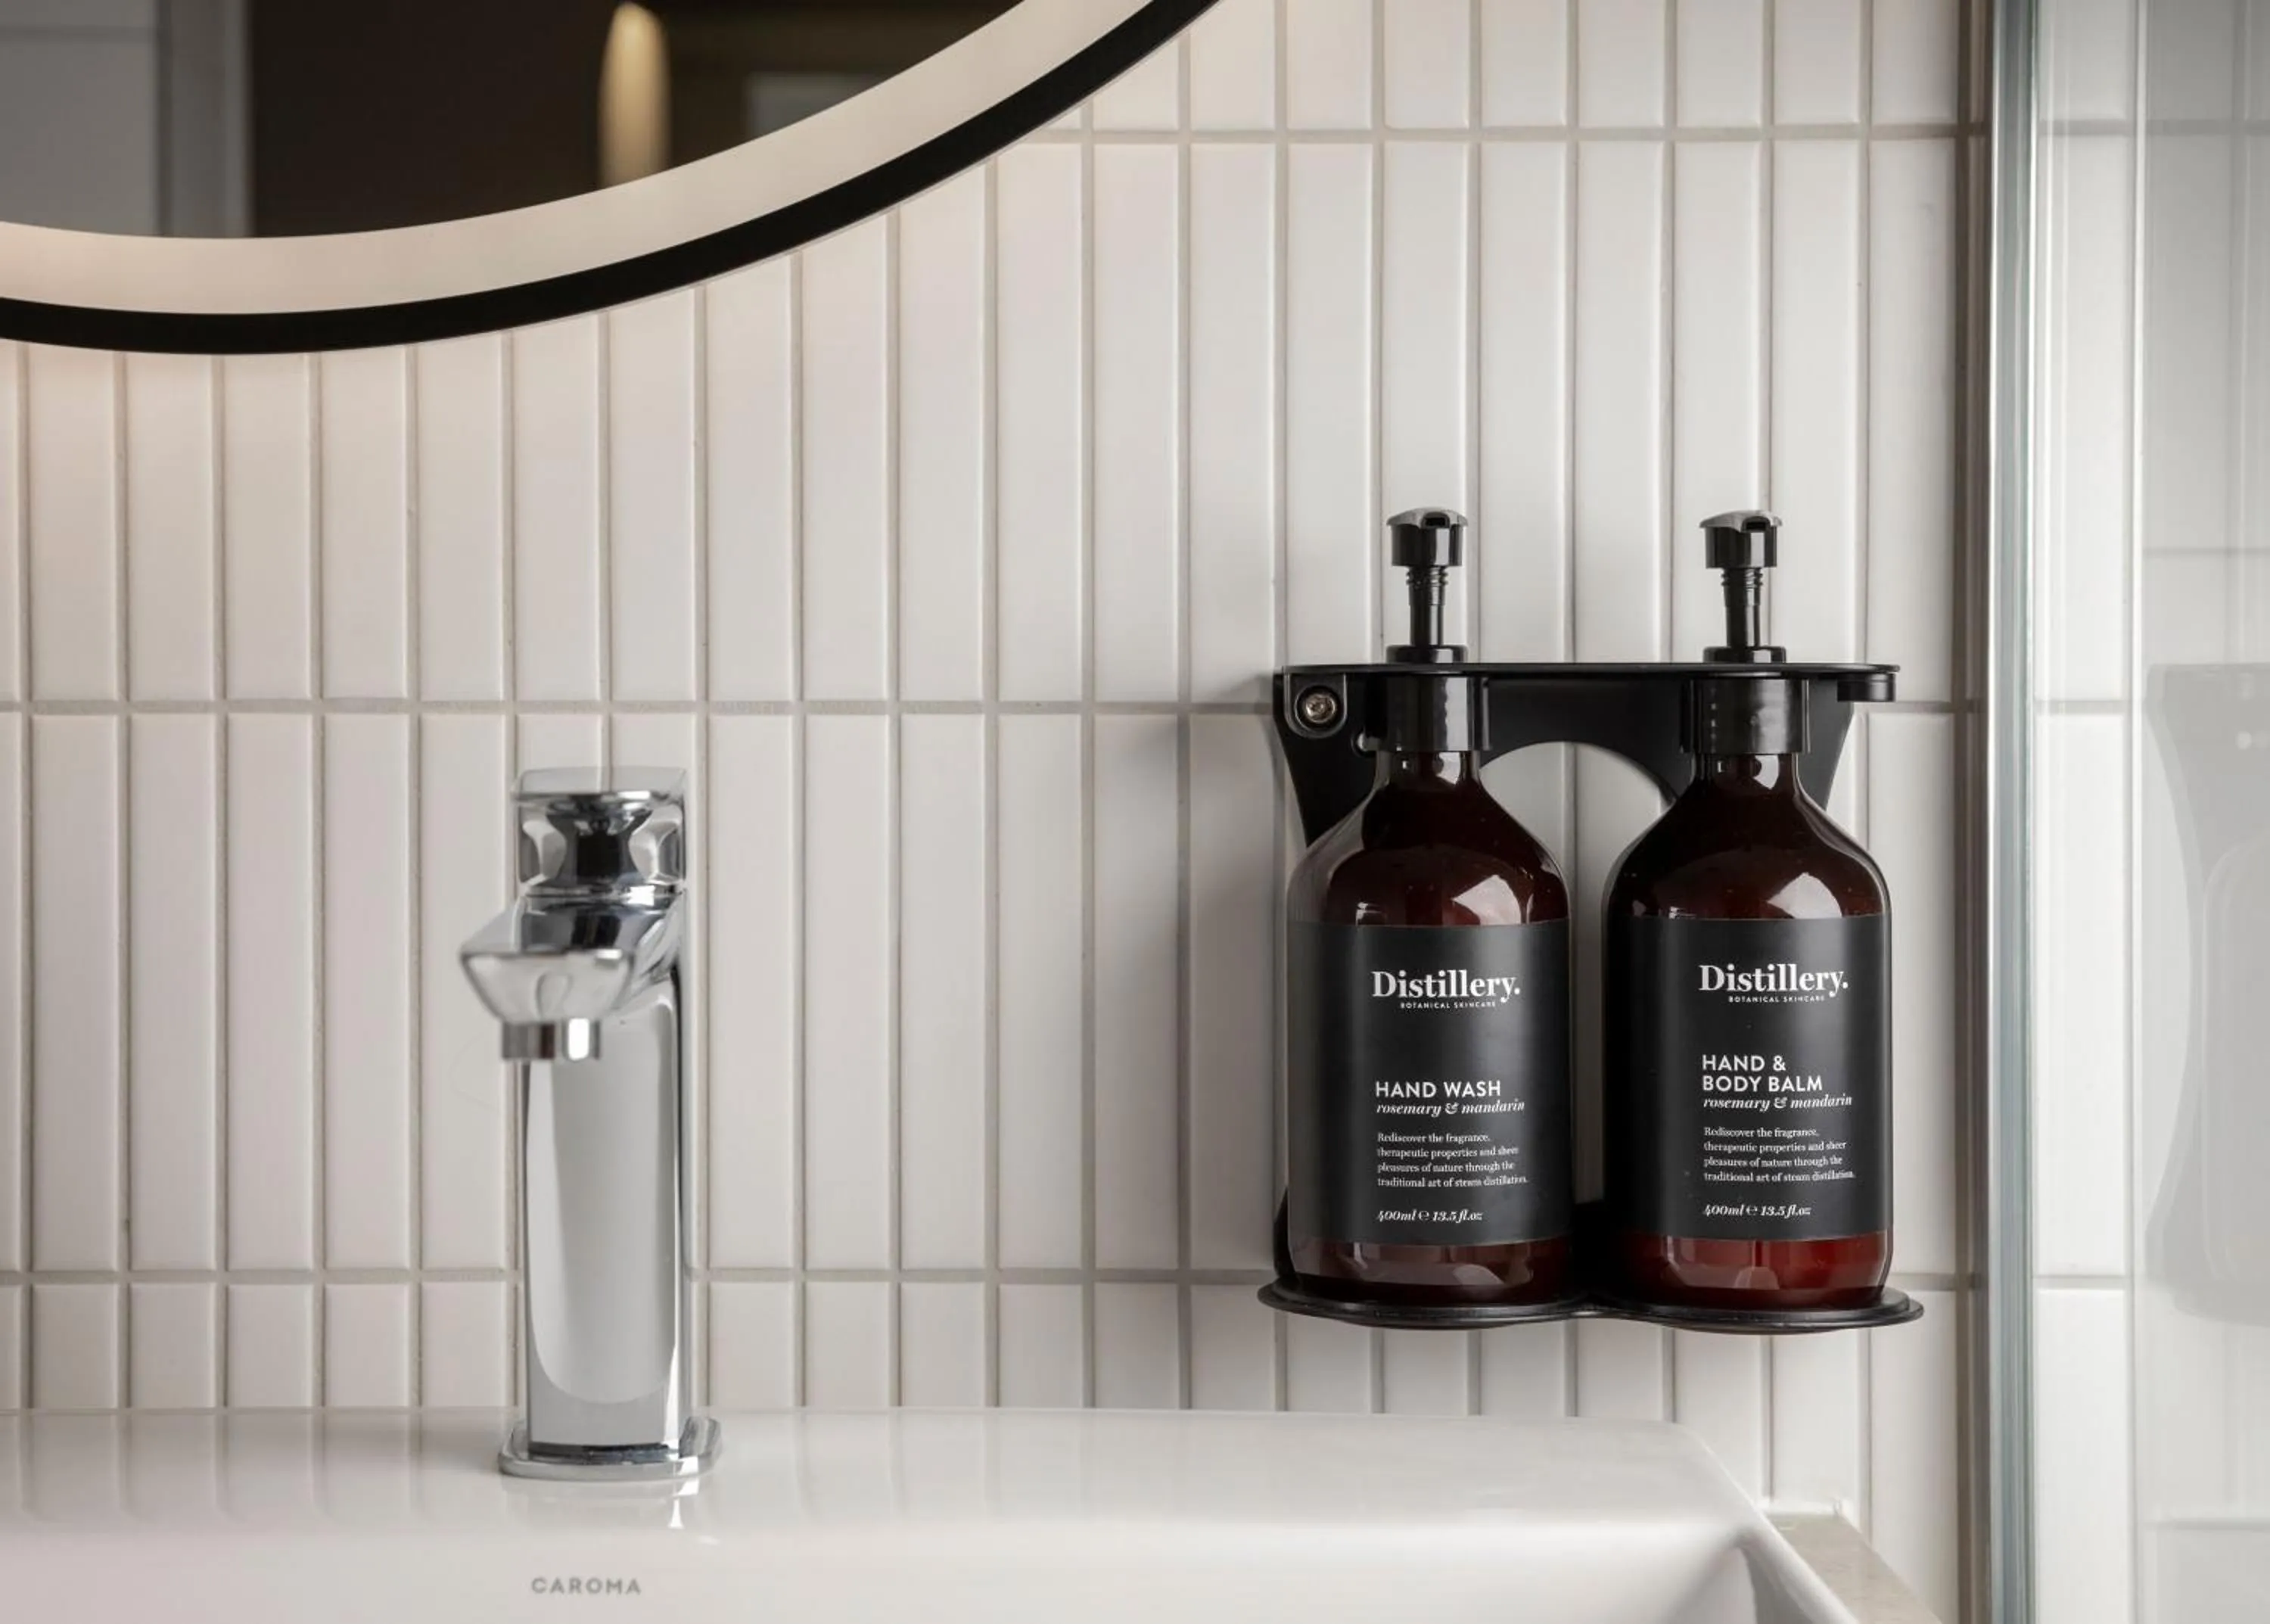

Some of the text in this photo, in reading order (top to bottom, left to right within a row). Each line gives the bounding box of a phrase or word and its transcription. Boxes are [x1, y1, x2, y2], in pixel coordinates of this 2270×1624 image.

[1371, 969, 1520, 1003] Distillery.
[1698, 963, 1849, 997] Distillery.
[1702, 1055, 1786, 1072] HAND &
[1376, 1080, 1501, 1098] HAND WASH
[1702, 1075, 1823, 1092] BODY BALM
[1376, 1098, 1525, 1117] rosemary & mandarin
[1703, 1093, 1852, 1112] rosemary & mandarin
[1377, 1132, 1426, 1142] Rediscover
[1429, 1133, 1444, 1142] the
[1703, 1127, 1755, 1137] Rediscover
[1757, 1128, 1773, 1137] the
[1377, 1146, 1519, 1159] therapeutic properties and sheer
[1703, 1140, 1847, 1154] therapeutic properties and sheer
[1377, 1160, 1515, 1173] pleasures of nature through the
[1703, 1155, 1843, 1168] pleasures of nature through the
[1378, 1178, 1426, 1187] traditional
[1443, 1178, 1454, 1187] of
[1704, 1172, 1754, 1181] traditional
[1755, 1173, 1769, 1181] art
[1771, 1172, 1783, 1181] of
[1783, 1173, 1811, 1181] steam
[1376, 1209, 1416, 1222] 400ml
[1704, 1204, 1744, 1217] 400ml
[531, 1576, 642, 1594] CAROMA
